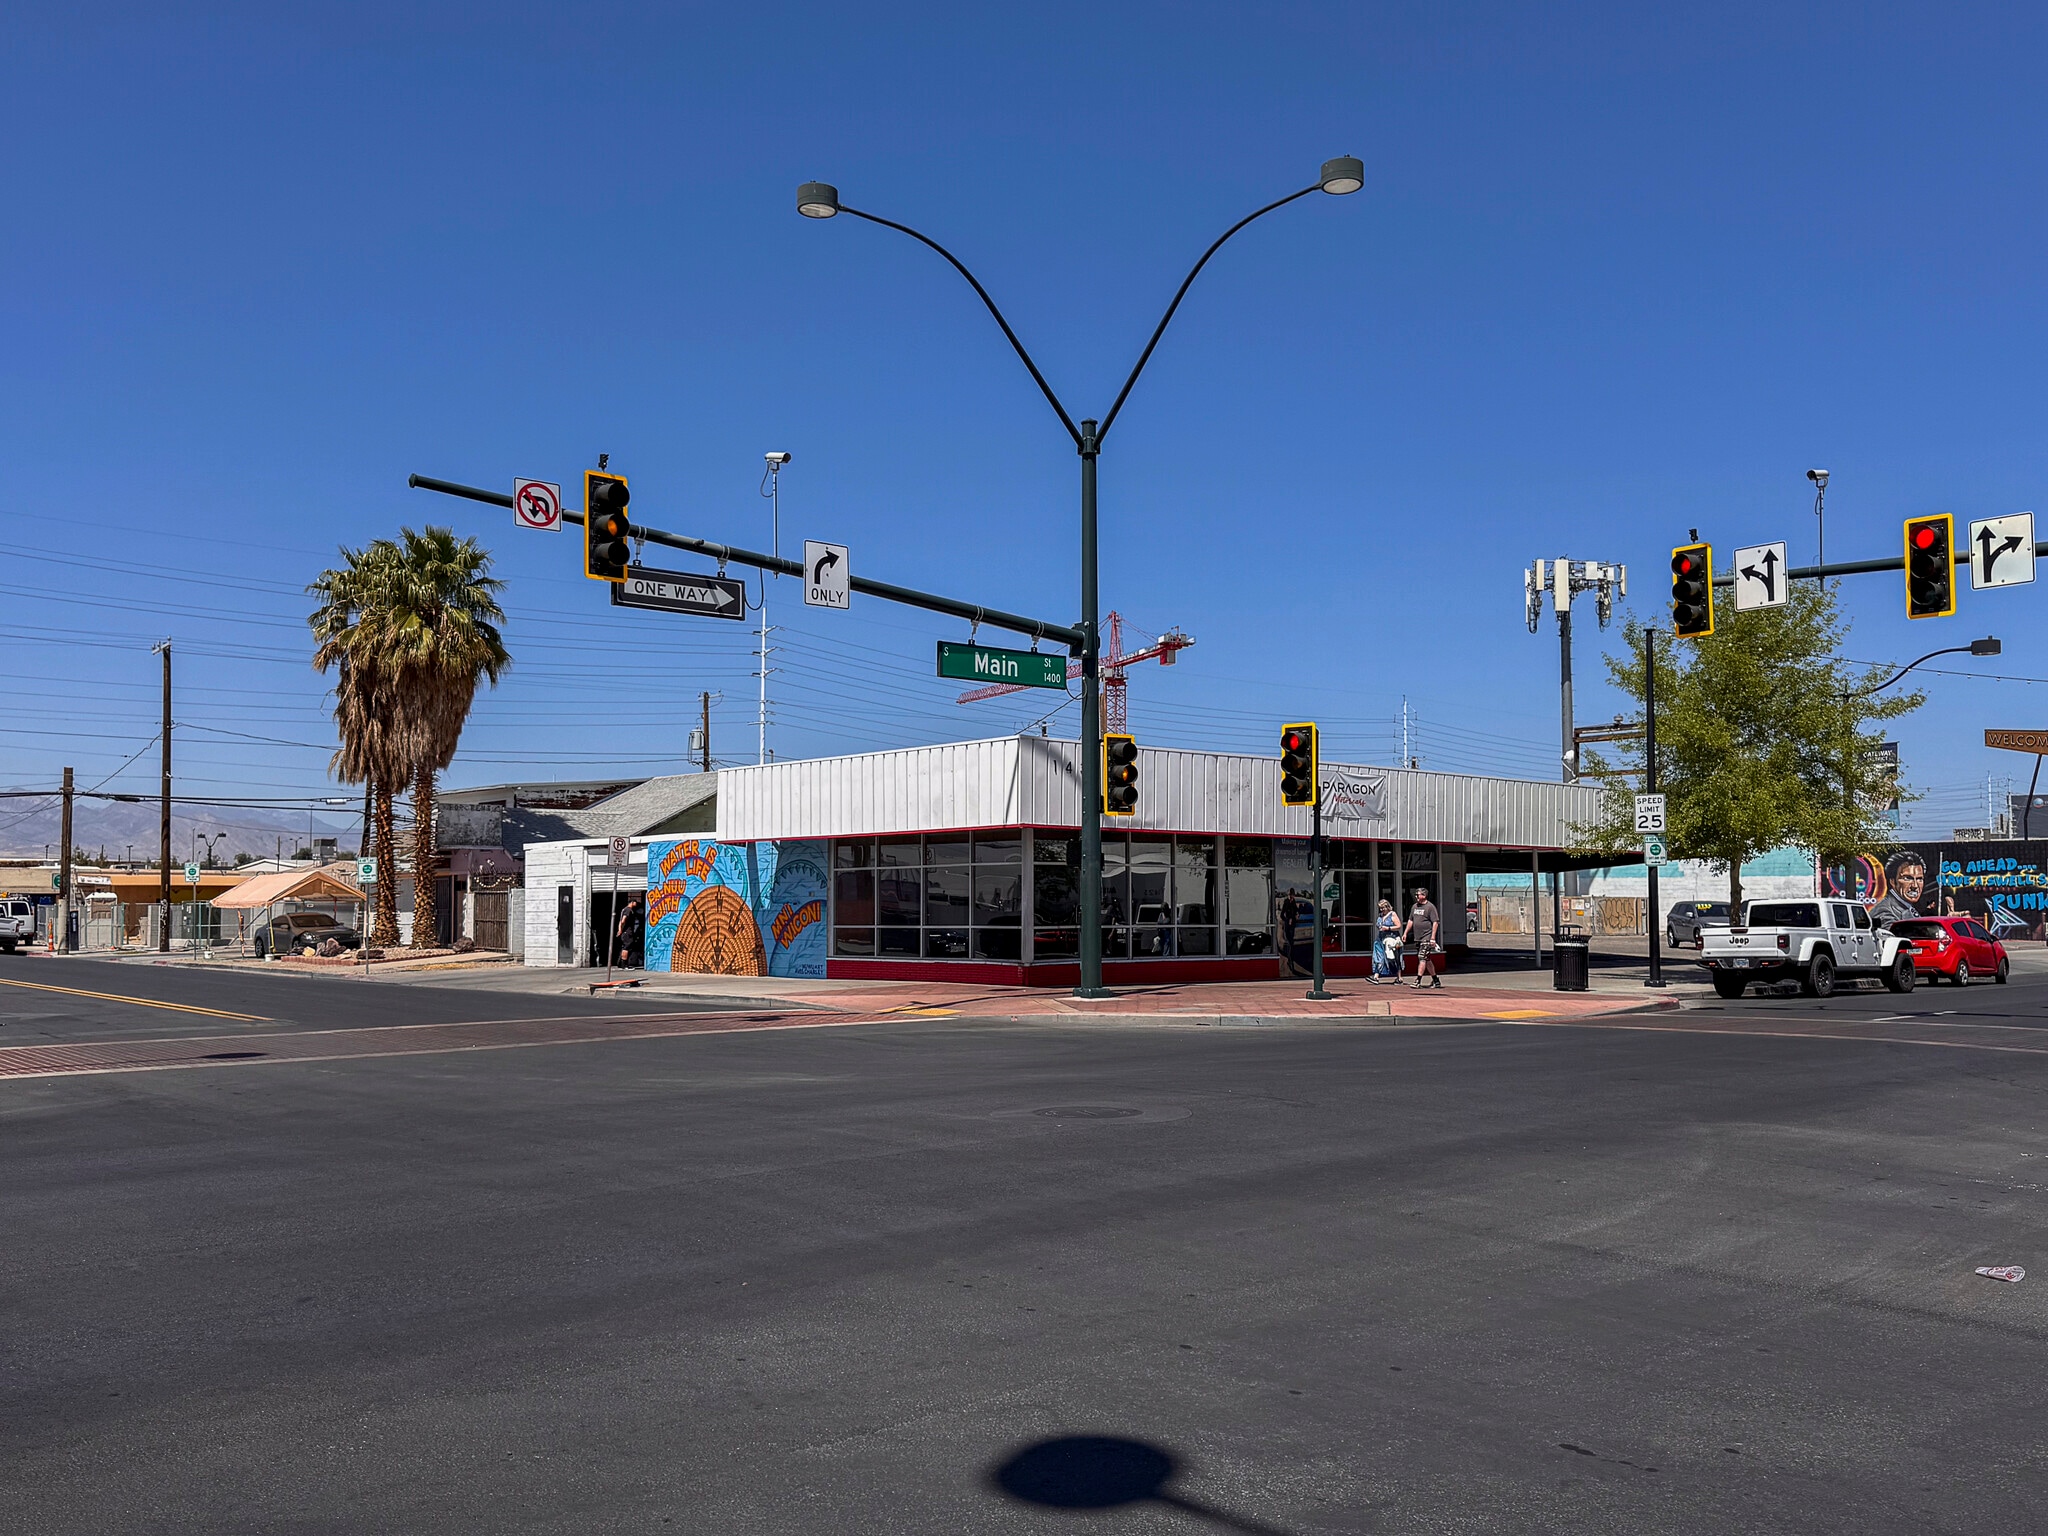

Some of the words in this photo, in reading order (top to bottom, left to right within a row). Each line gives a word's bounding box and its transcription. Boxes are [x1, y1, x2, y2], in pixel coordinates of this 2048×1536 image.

[634, 580, 666, 597] ONE
[674, 585, 709, 602] WAY
[811, 588, 844, 603] ONLY
[943, 646, 949, 657] S
[974, 651, 1018, 677] Main
[1044, 657, 1052, 668] St
[1043, 672, 1061, 684] 1400
[1322, 781, 1376, 796] PARAGON
[1638, 814, 1662, 829] 25
[659, 840, 700, 878] WATER
[705, 845, 718, 865] IS
[1941, 860, 1961, 873] GO
[686, 859, 711, 883] LIFE
[1987, 874, 2034, 887] SWELL
[771, 902, 795, 942] MNI
[780, 901, 822, 951] WICONI
[1729, 936, 1750, 945] Jeep
